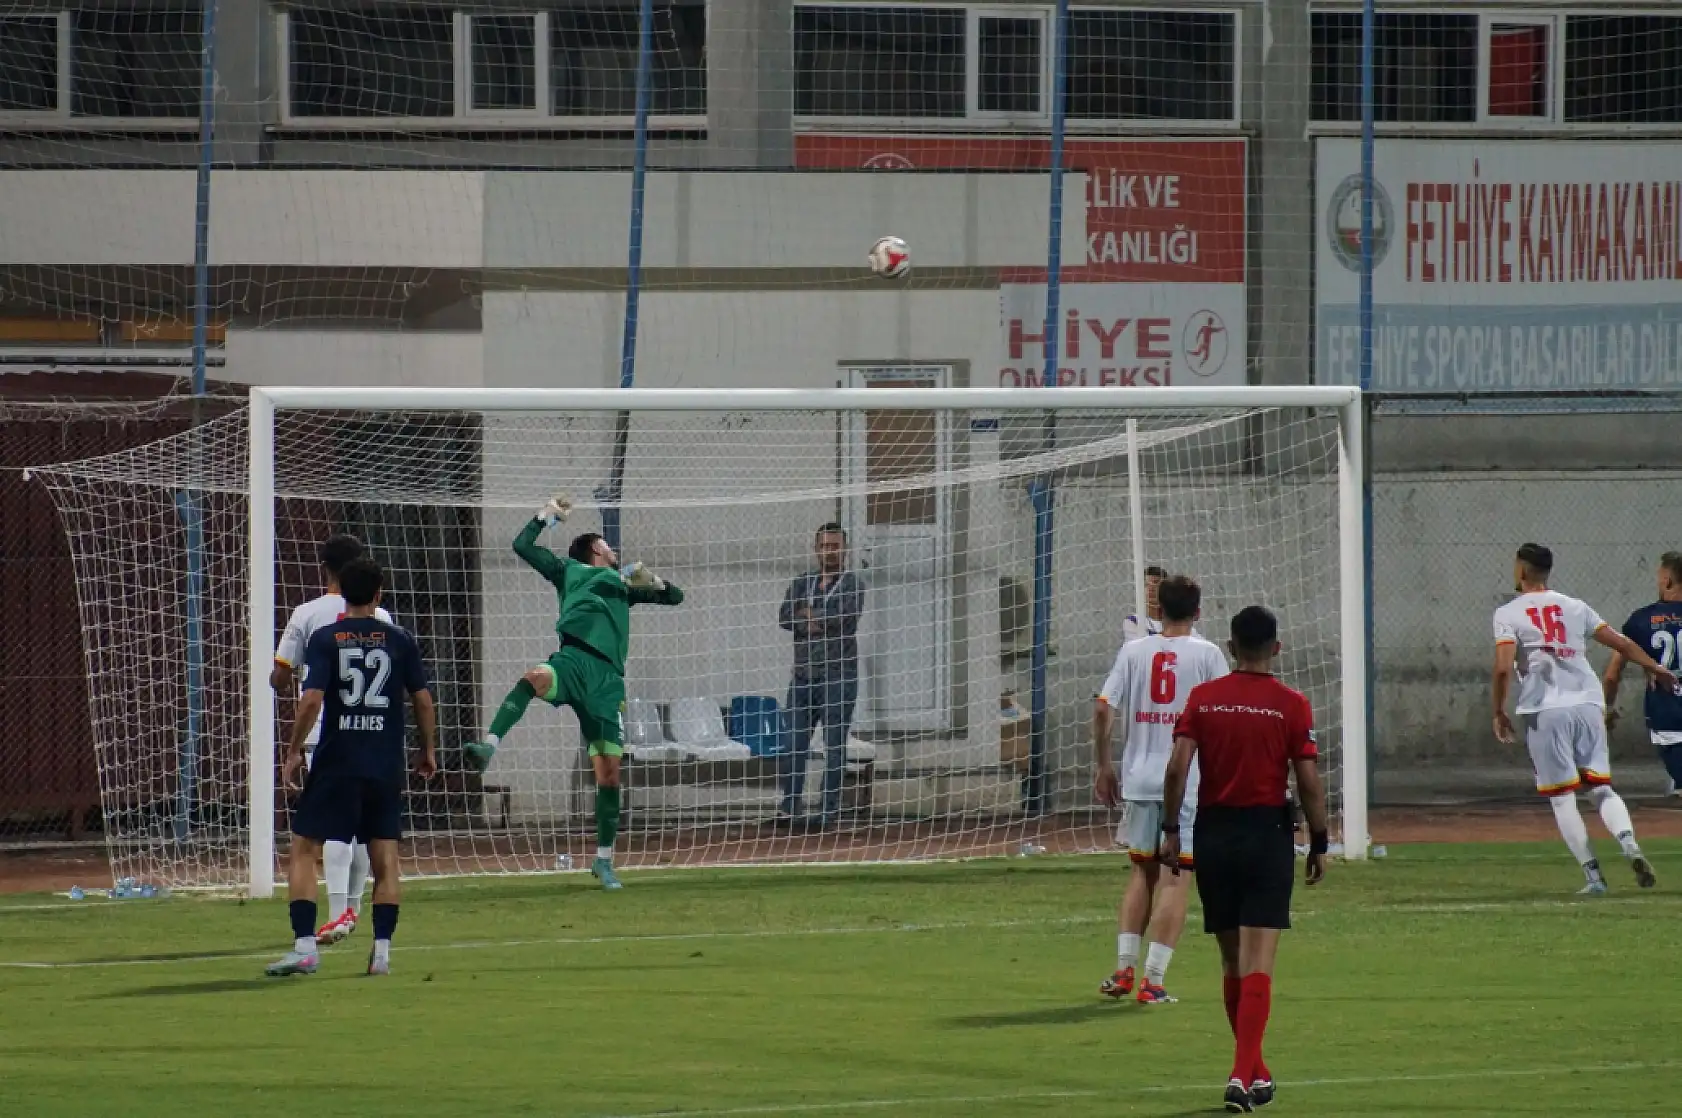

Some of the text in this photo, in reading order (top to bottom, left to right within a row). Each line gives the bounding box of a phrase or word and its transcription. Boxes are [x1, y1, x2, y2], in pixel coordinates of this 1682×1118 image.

[1085, 167, 1180, 207] LİK VE
[1407, 158, 1511, 282] FETHİYE
[1009, 309, 1172, 359] HİYE
[338, 647, 391, 708] 52
[1151, 652, 1177, 704] 6
